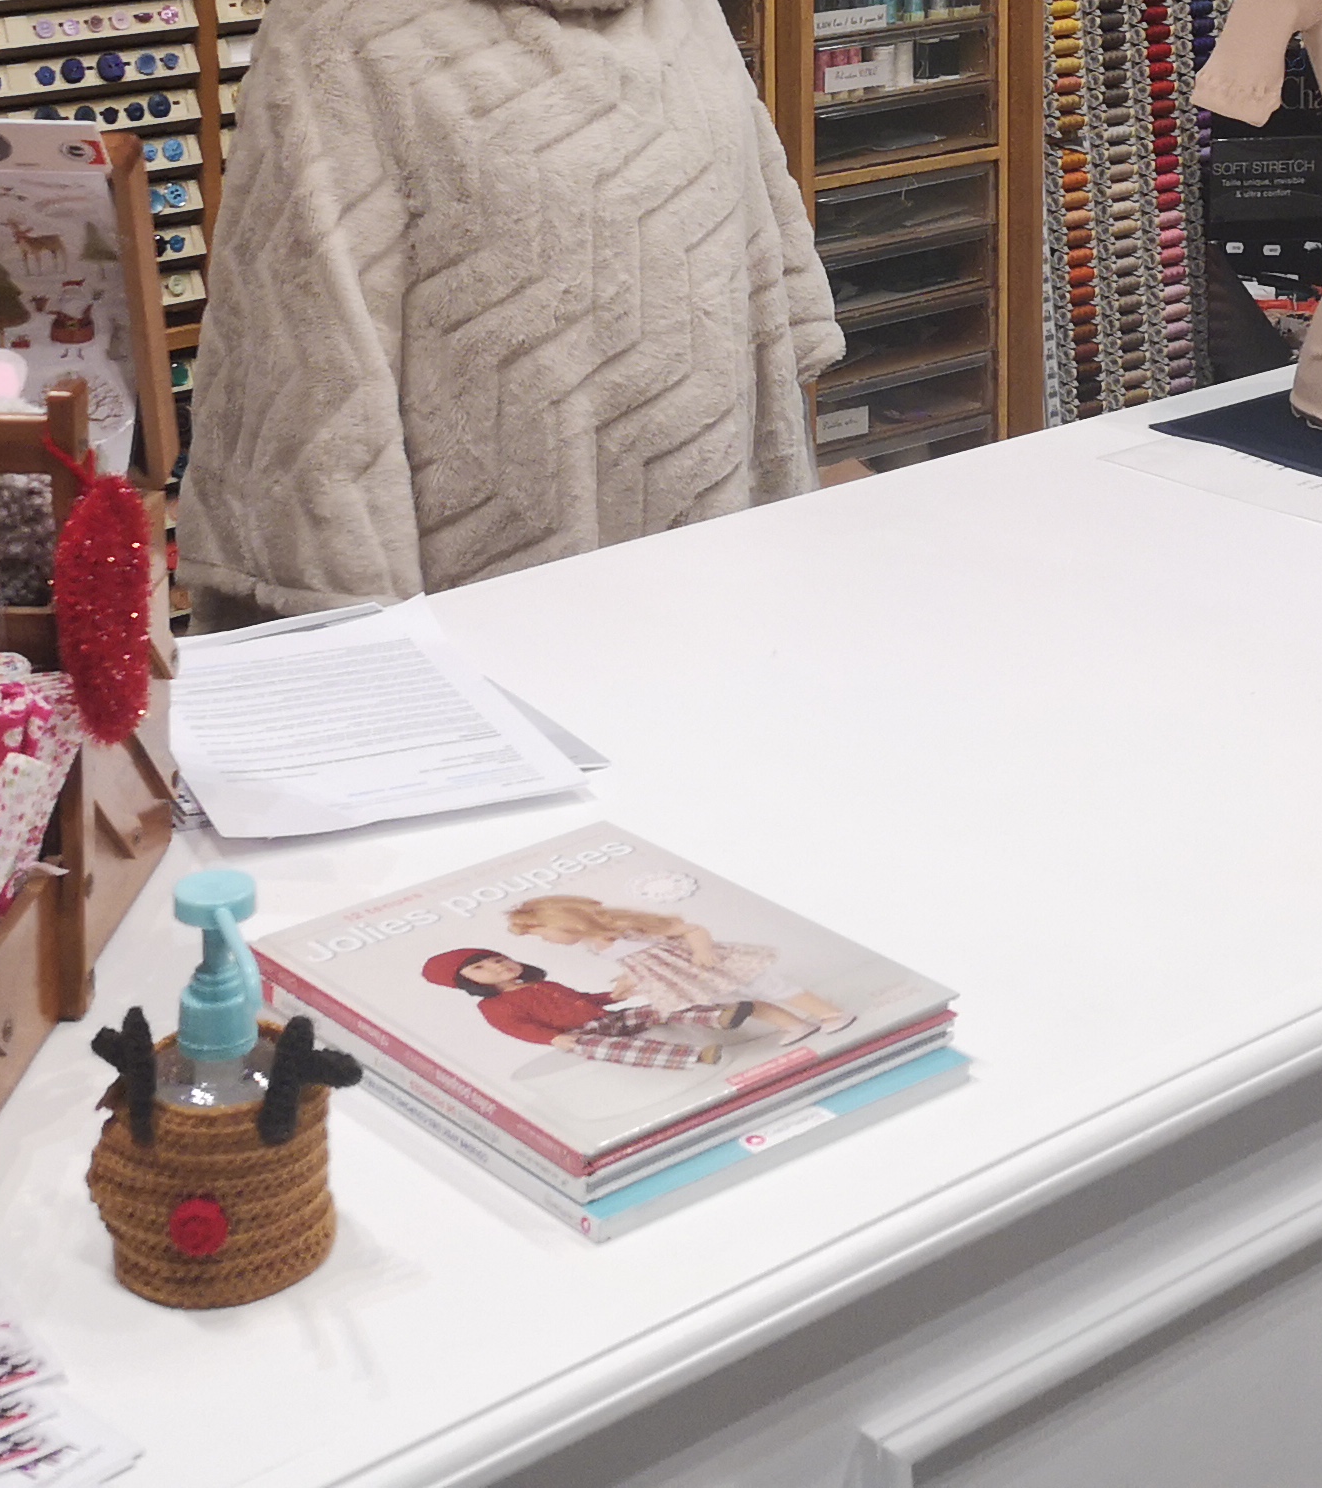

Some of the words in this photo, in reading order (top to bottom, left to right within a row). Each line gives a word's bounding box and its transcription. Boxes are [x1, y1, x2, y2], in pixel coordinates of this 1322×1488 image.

[1211, 162, 1249, 176] SOFT
[1251, 159, 1315, 174] STRETCH
[1262, 188, 1292, 198] confort
[303, 903, 443, 964] Jolies
[440, 838, 638, 919] poupées
